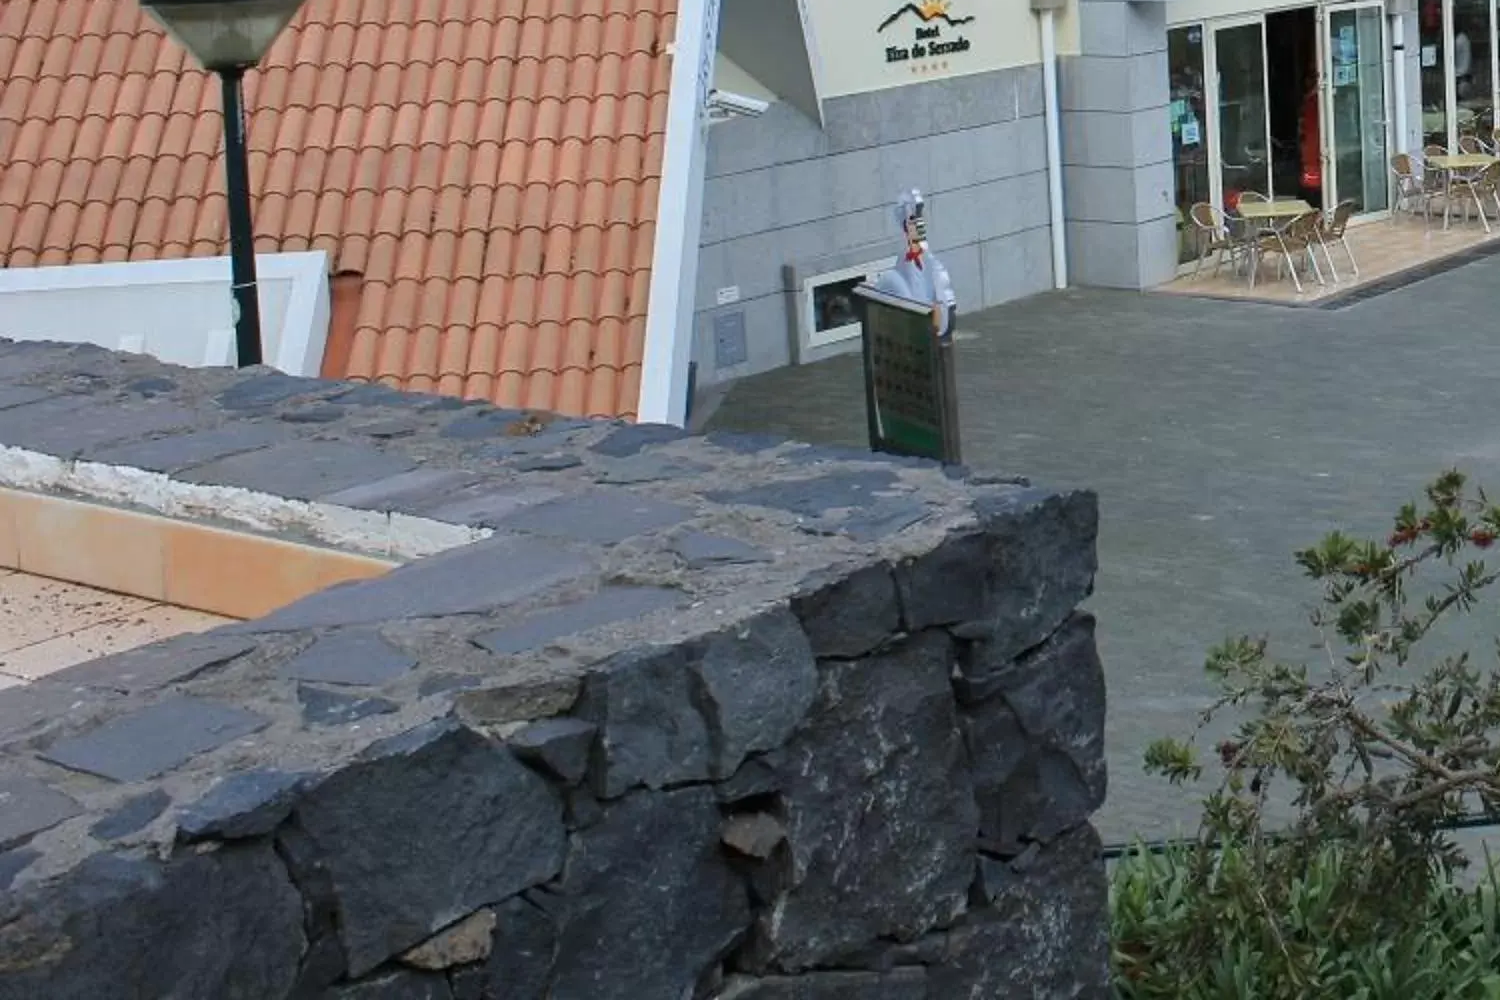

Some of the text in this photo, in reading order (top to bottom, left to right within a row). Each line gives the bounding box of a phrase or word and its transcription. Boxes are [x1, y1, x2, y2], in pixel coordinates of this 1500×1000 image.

[915, 25, 940, 40] Hotel
[911, 43, 926, 58] do
[928, 36, 970, 56] Serrado
